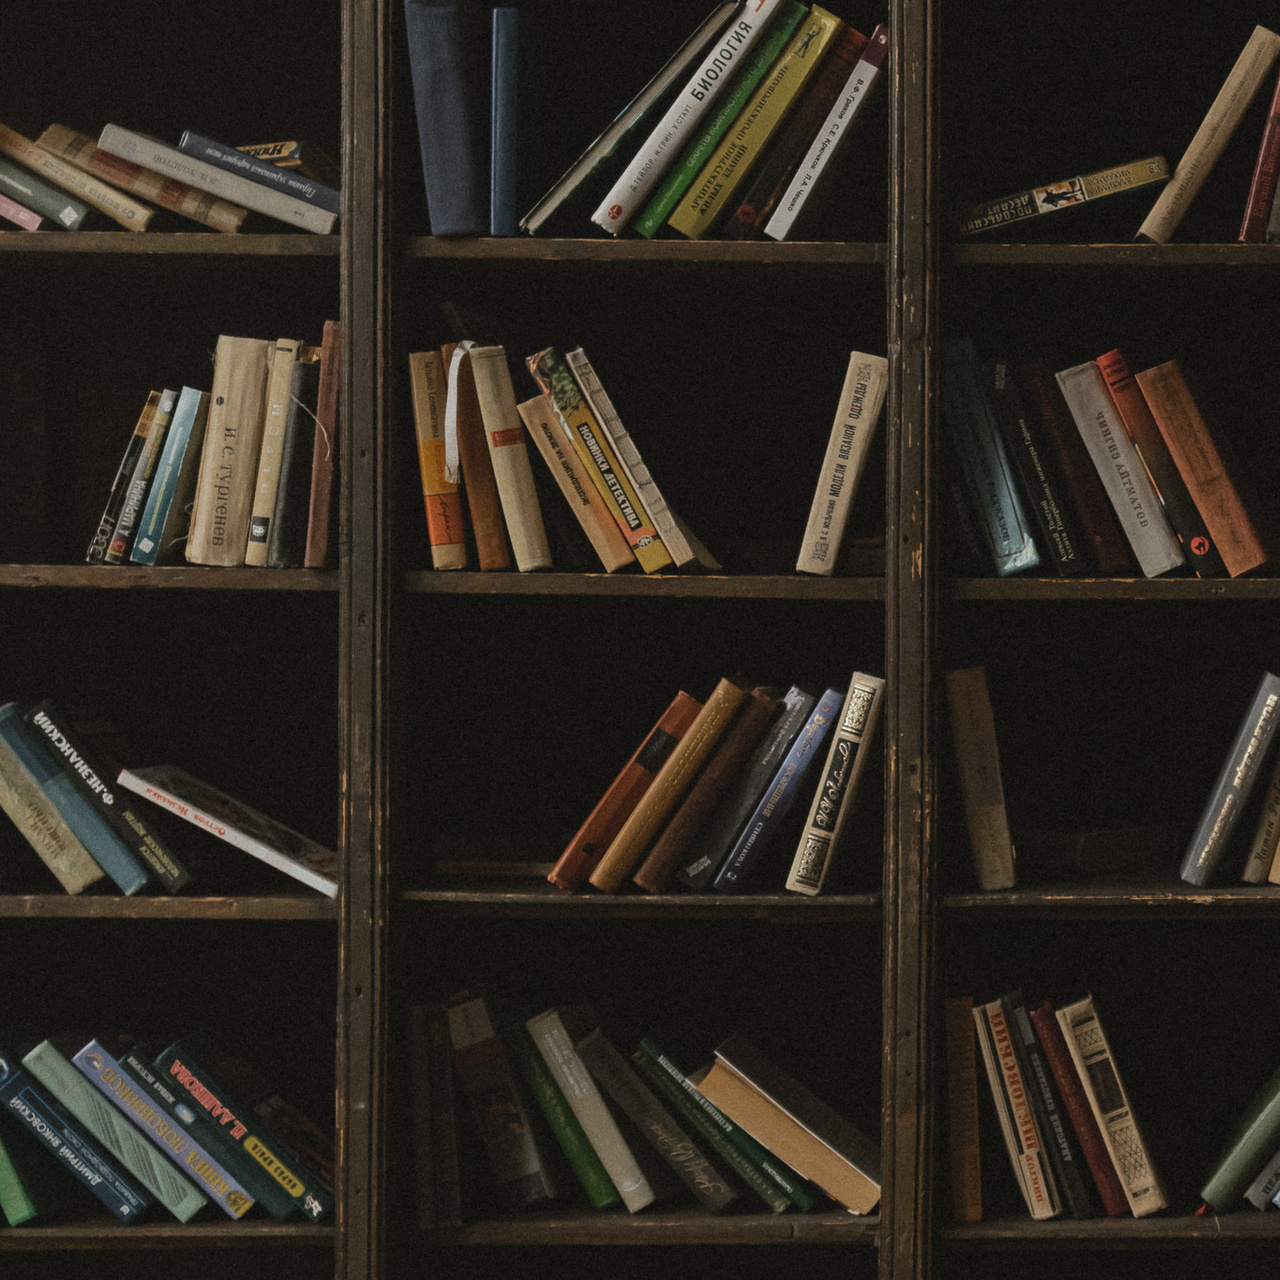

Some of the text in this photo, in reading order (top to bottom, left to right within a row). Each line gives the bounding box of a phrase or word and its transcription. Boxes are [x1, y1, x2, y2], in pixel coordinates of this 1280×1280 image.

[688, 18, 755, 103] БИОЛОГИЯ
[688, 61, 791, 213] АРХИТЕКТУРНОЕ ПРОЕКТИРОВАНИЕ
[696, 141, 750, 218] ЖИЛЫХ ЗДАНИЙ
[577, 423, 641, 529] НОВИНКИ ДЕТЕКТИВА
[827, 380, 871, 498] МОДЕЛИ ВЯЗАНОЙ ОДЕЖДЫ
[1091, 409, 1154, 530] ЧИНГИЗ АЙТМАТОВ
[29, 708, 119, 808] Ф.НЕЗНАНСКИЙ
[191, 812, 227, 837] Остров
[6, 1094, 104, 1188] ДМИТРИЙ ЯНКОВСКИЙ
[96, 1064, 232, 1198] КНИГА ЛЮБОВНИКОВ
[164, 1058, 239, 1128] ДАШКОВА
[988, 1009, 1047, 1205] ВИКТОР ШКЛОВСКИЙ
[1048, 1111, 1073, 1162] АНАТОЛИЙ
